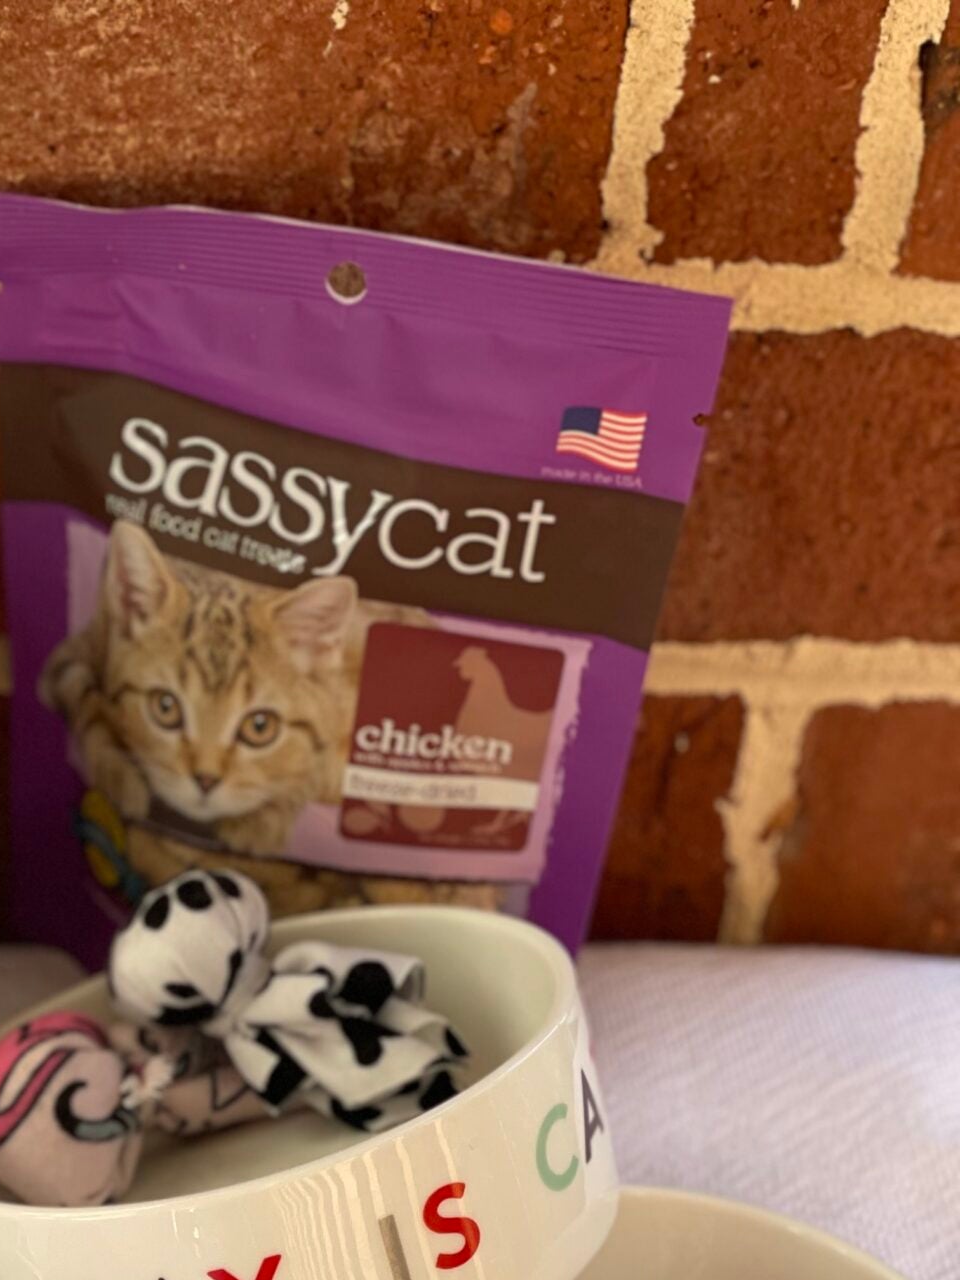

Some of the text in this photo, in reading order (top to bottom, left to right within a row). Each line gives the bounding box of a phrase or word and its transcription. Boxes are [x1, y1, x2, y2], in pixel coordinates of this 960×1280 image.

[109, 417, 557, 582] sassycat
[149, 503, 204, 542] food
[203, 527, 240, 554] cat
[355, 717, 514, 765] chicken
